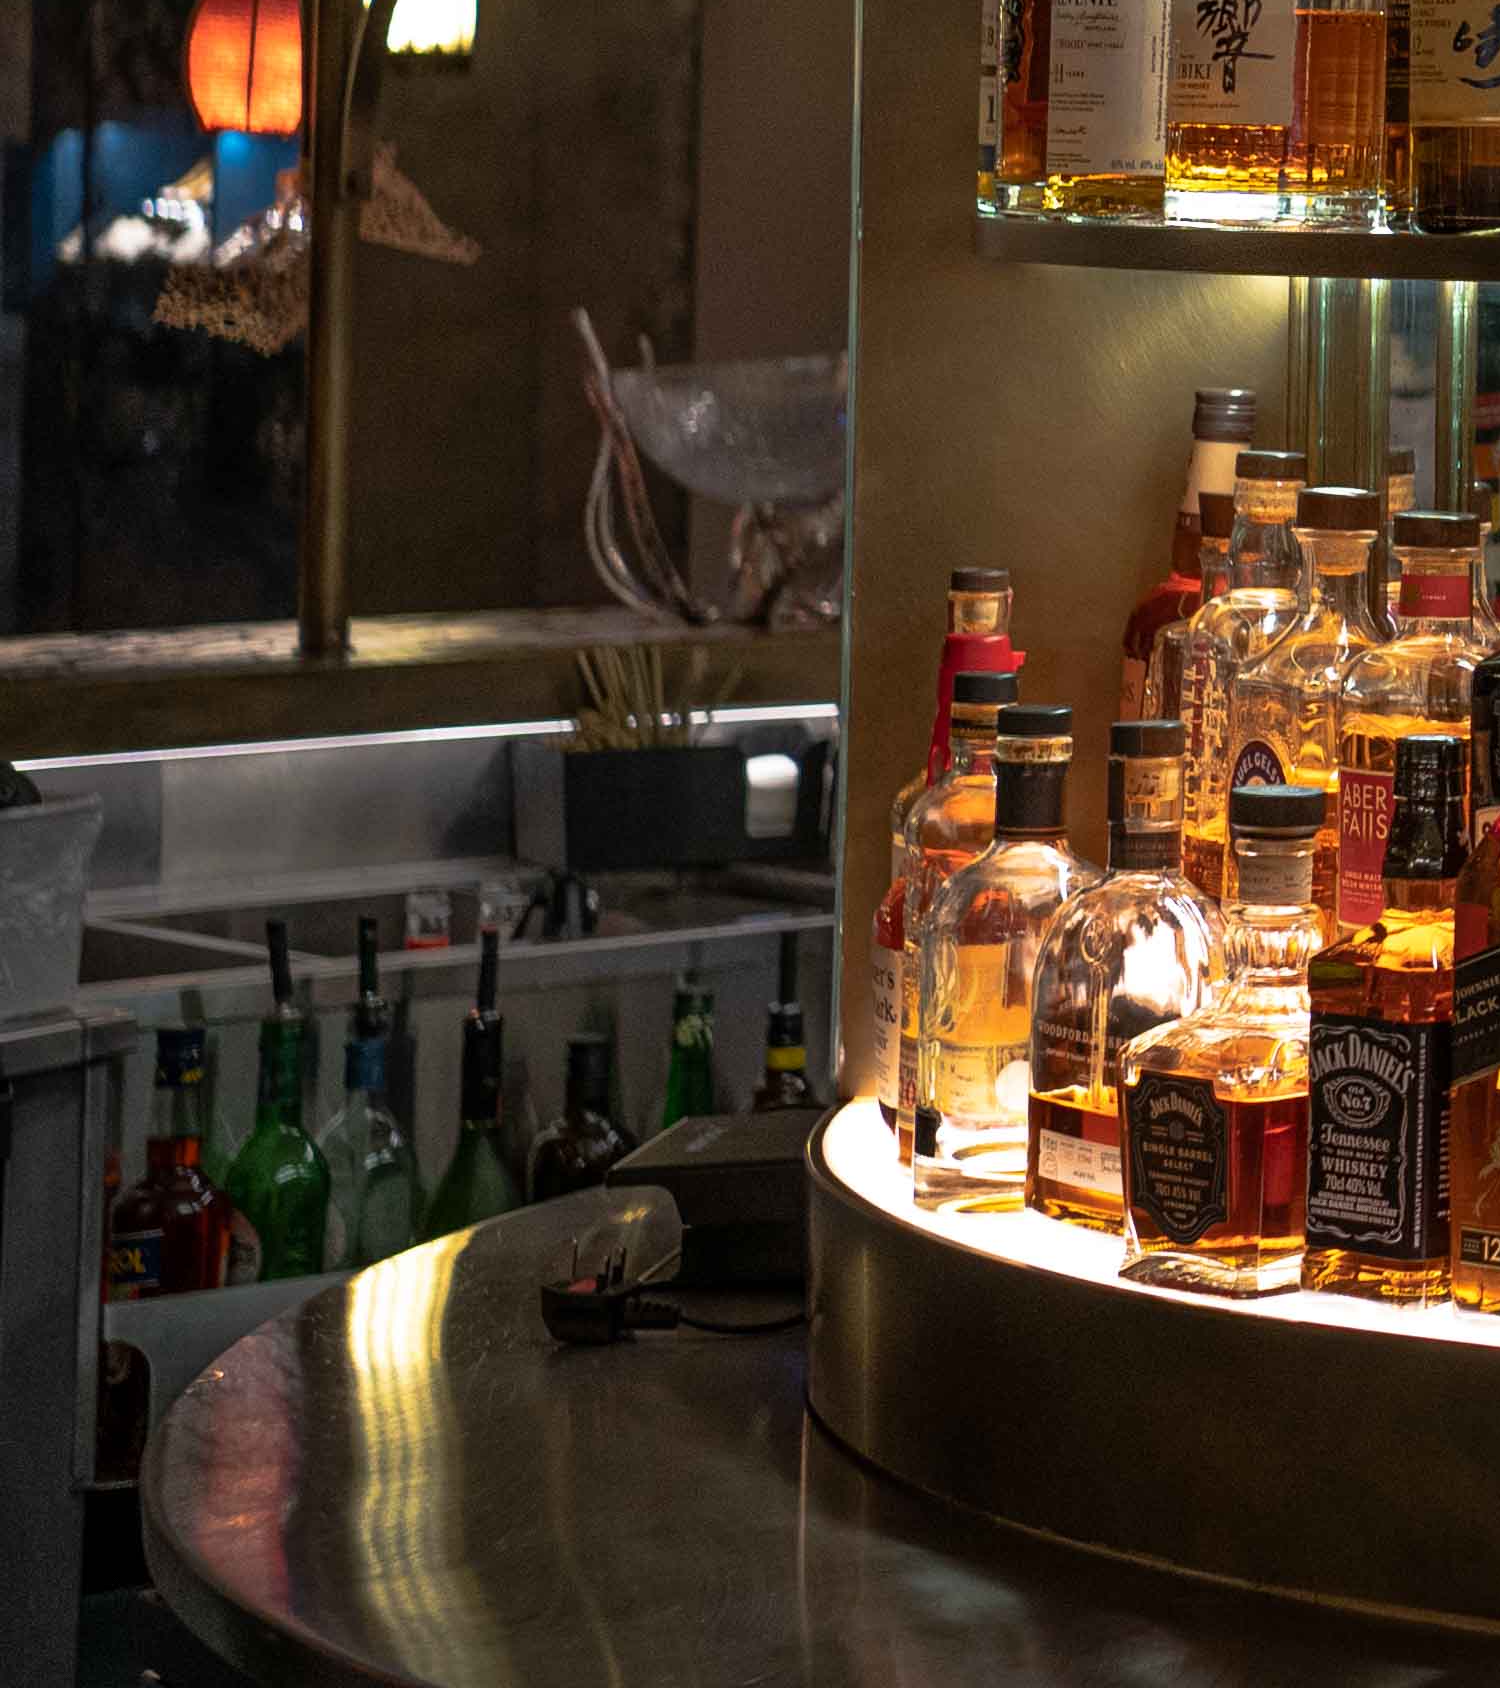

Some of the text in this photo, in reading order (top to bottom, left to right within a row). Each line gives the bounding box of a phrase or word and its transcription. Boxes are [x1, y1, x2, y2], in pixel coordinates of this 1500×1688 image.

[1343, 782, 1389, 812] ABER
[1455, 976, 1500, 1004] JOHNNIE
[1311, 1032, 1416, 1096] JACK DANIEL'S
[1142, 1141, 1214, 1162] SINGLE BARREL
[1320, 1123, 1391, 1154] Tennessee
[1163, 1159, 1195, 1172] SELECT
[1321, 1156, 1389, 1180] WHISKEY
